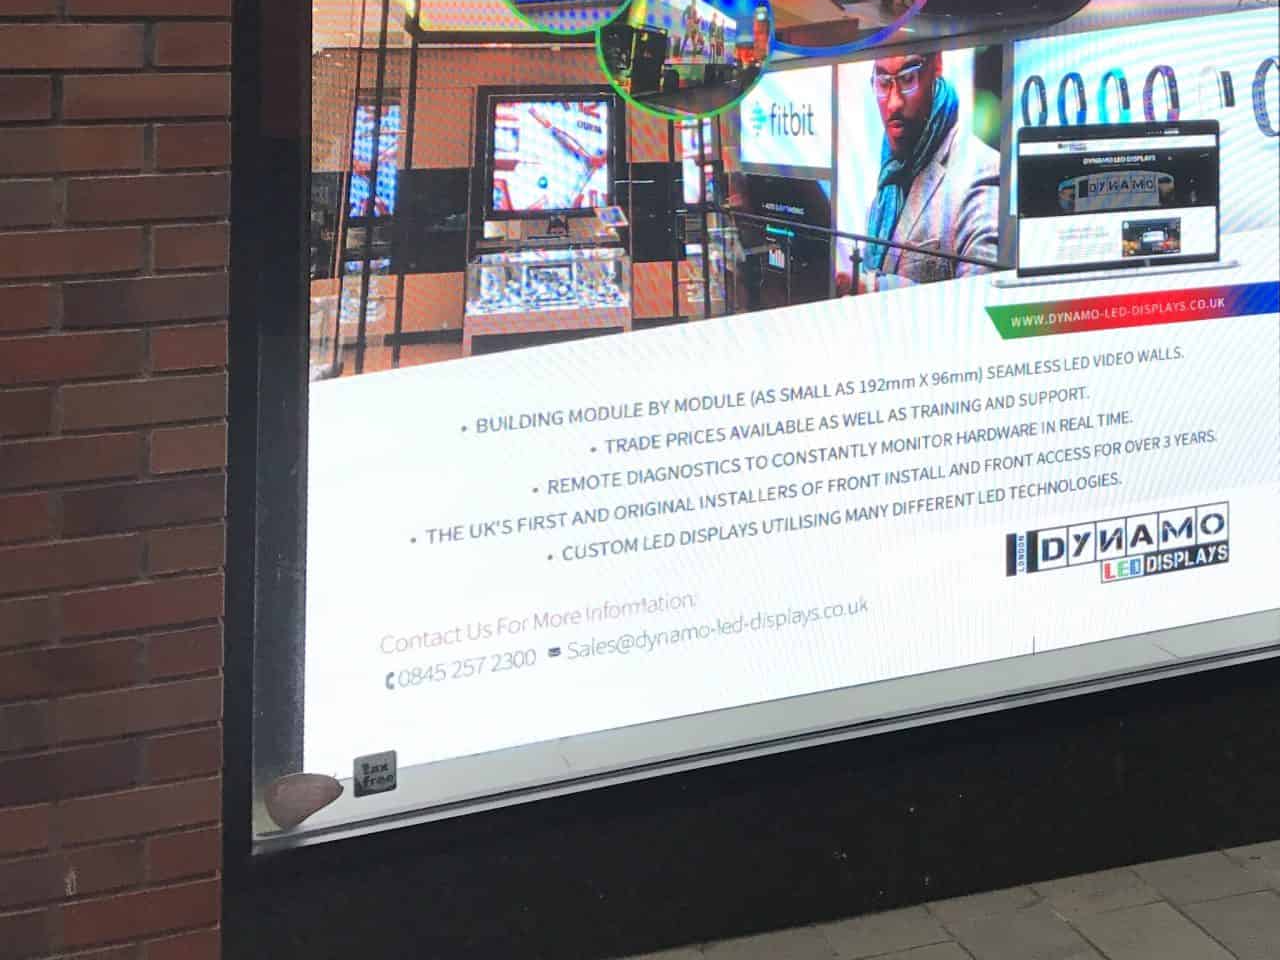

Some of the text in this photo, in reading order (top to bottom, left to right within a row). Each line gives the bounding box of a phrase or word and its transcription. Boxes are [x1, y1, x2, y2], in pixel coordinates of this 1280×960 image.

[768, 101, 815, 137] fitbit
[1010, 297, 1226, 328] WWW.DYNAMO-LED-DISPLAYS.CO.UK
[476, 346, 1184, 433] BUILDING MODULE BY MODULE (AS SMALL AS 192mm X 96mm) SEAMLESS LED VIDEO WALLS.
[605, 386, 1090, 454] TRADE PRICES AVAILABLE AS WELL AS TRAINING AND SUPPORT.
[548, 411, 1133, 495] REMOTE DIAGNOSTICS TO CONSTANTLY MONITOR HARDWARE IN REAL TIME.
[426, 429, 1217, 544] THE UK'S FIRST AND ORIGINAL INSTALLERS OF FRONT INSTALL AND FRONT ACCESS FOR OVER 3 YEARS.
[562, 472, 1122, 560] CUSTOM LED DISPLAYS UTILISING MANY DIFFERENT LED TECHNOLOGIES.
[1041, 512, 1226, 562] DYNAMO
[1017, 534, 1026, 573] LONDON
[1103, 542, 1230, 580] LED DISPLAYS
[380, 628, 465, 653] Contact
[467, 622, 493, 640] Us
[496, 618, 529, 635] For
[533, 610, 584, 630] More
[567, 596, 869, 660] Sales@dynamo-led-displays.co.uk
[398, 648, 536, 688] 0845 257 2300
